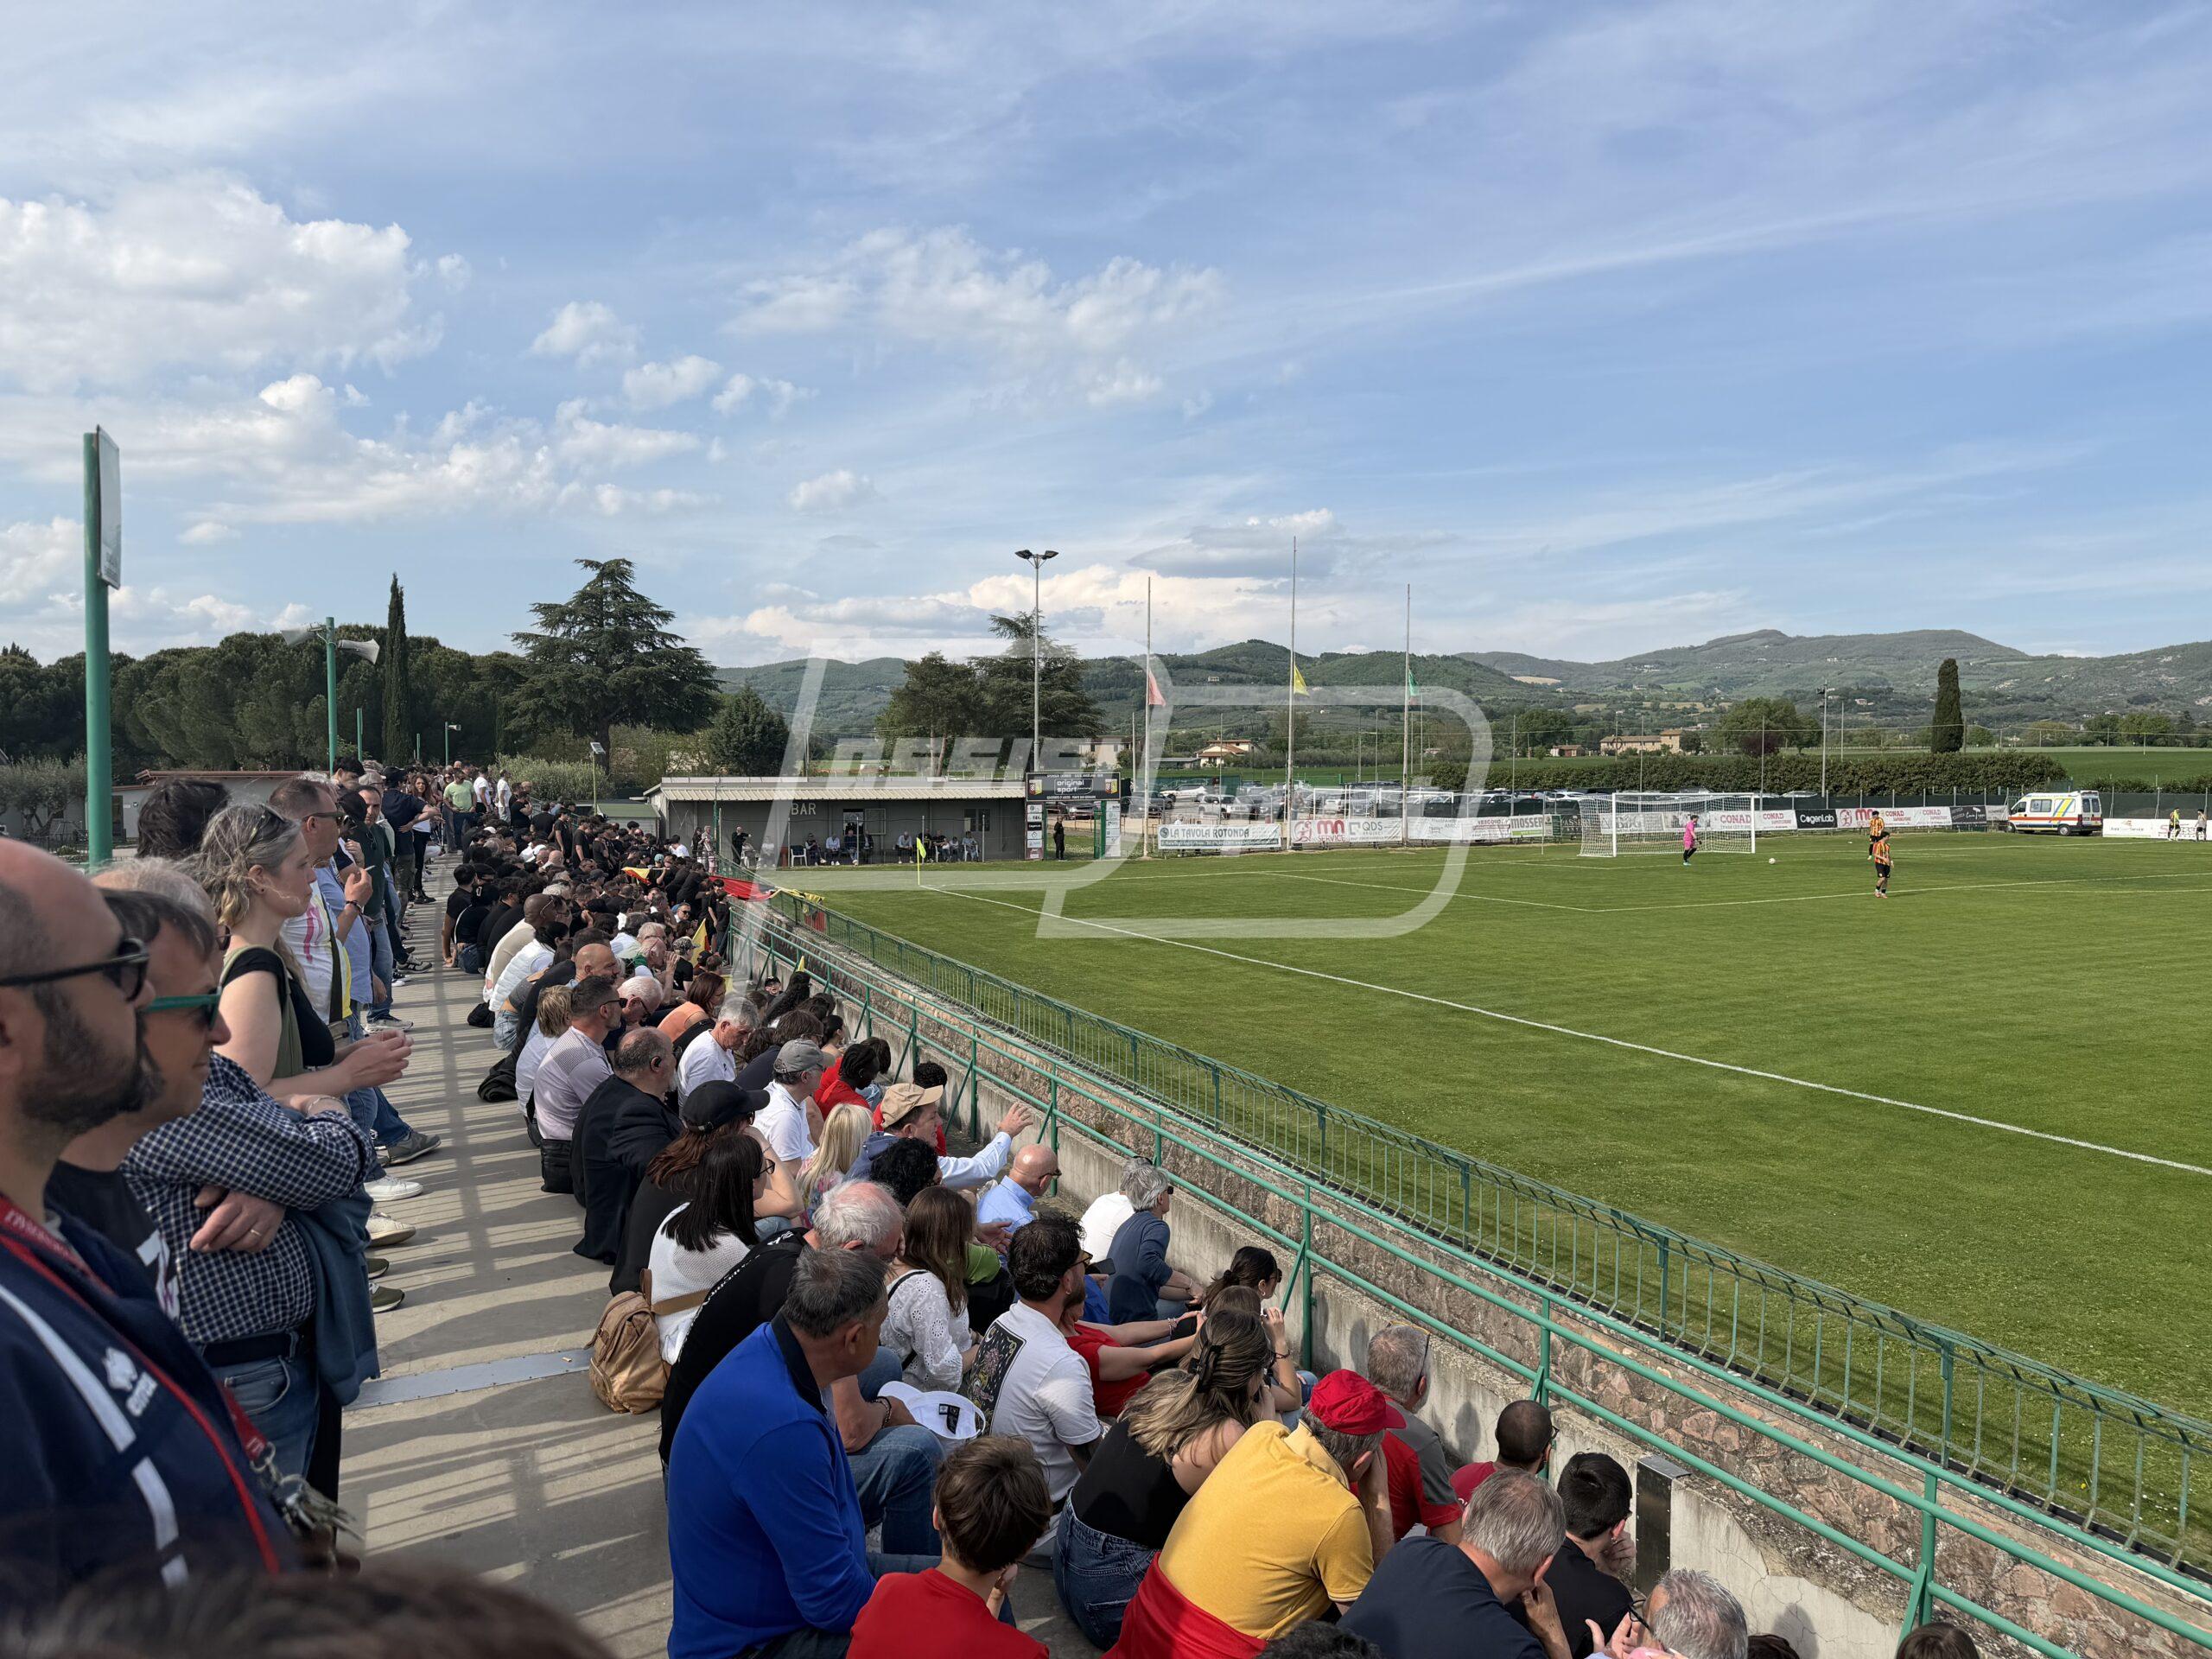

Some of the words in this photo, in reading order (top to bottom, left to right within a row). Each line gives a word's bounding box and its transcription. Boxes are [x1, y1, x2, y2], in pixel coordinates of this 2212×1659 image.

[791, 802, 817, 816] BAR
[1719, 814, 1751, 824] CONAD
[1800, 814, 1834, 824] CogenLab
[1362, 821, 1383, 831] QDS
[1170, 829, 1179, 838] LA
[1181, 829, 1211, 839] TAVOLA
[1212, 828, 1249, 839] ROTONDA
[1318, 834, 1346, 842] SERVICE
